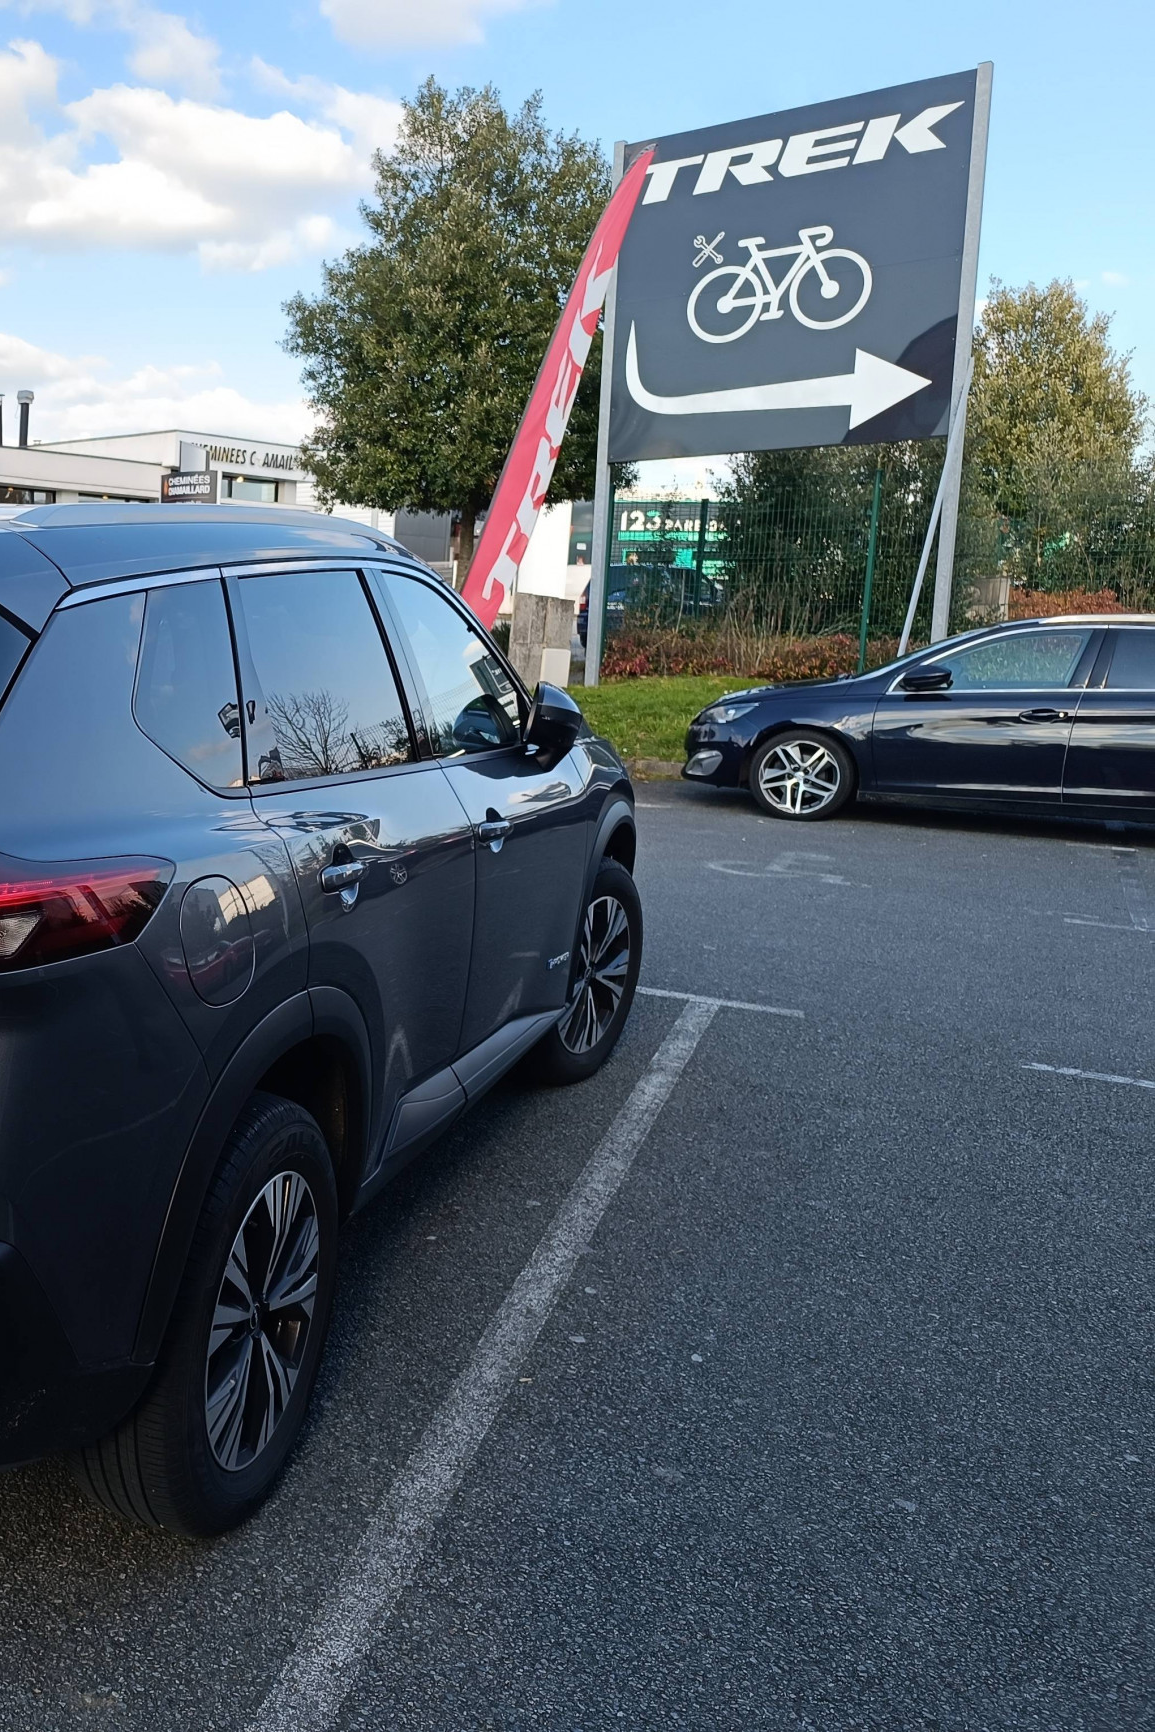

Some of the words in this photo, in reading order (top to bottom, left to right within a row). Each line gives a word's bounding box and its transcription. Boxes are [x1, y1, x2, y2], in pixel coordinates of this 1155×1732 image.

[642, 100, 965, 205] TREK
[482, 241, 614, 600] TREK
[168, 474, 211, 487] CHEMINÉES
[620, 510, 661, 531] 123
